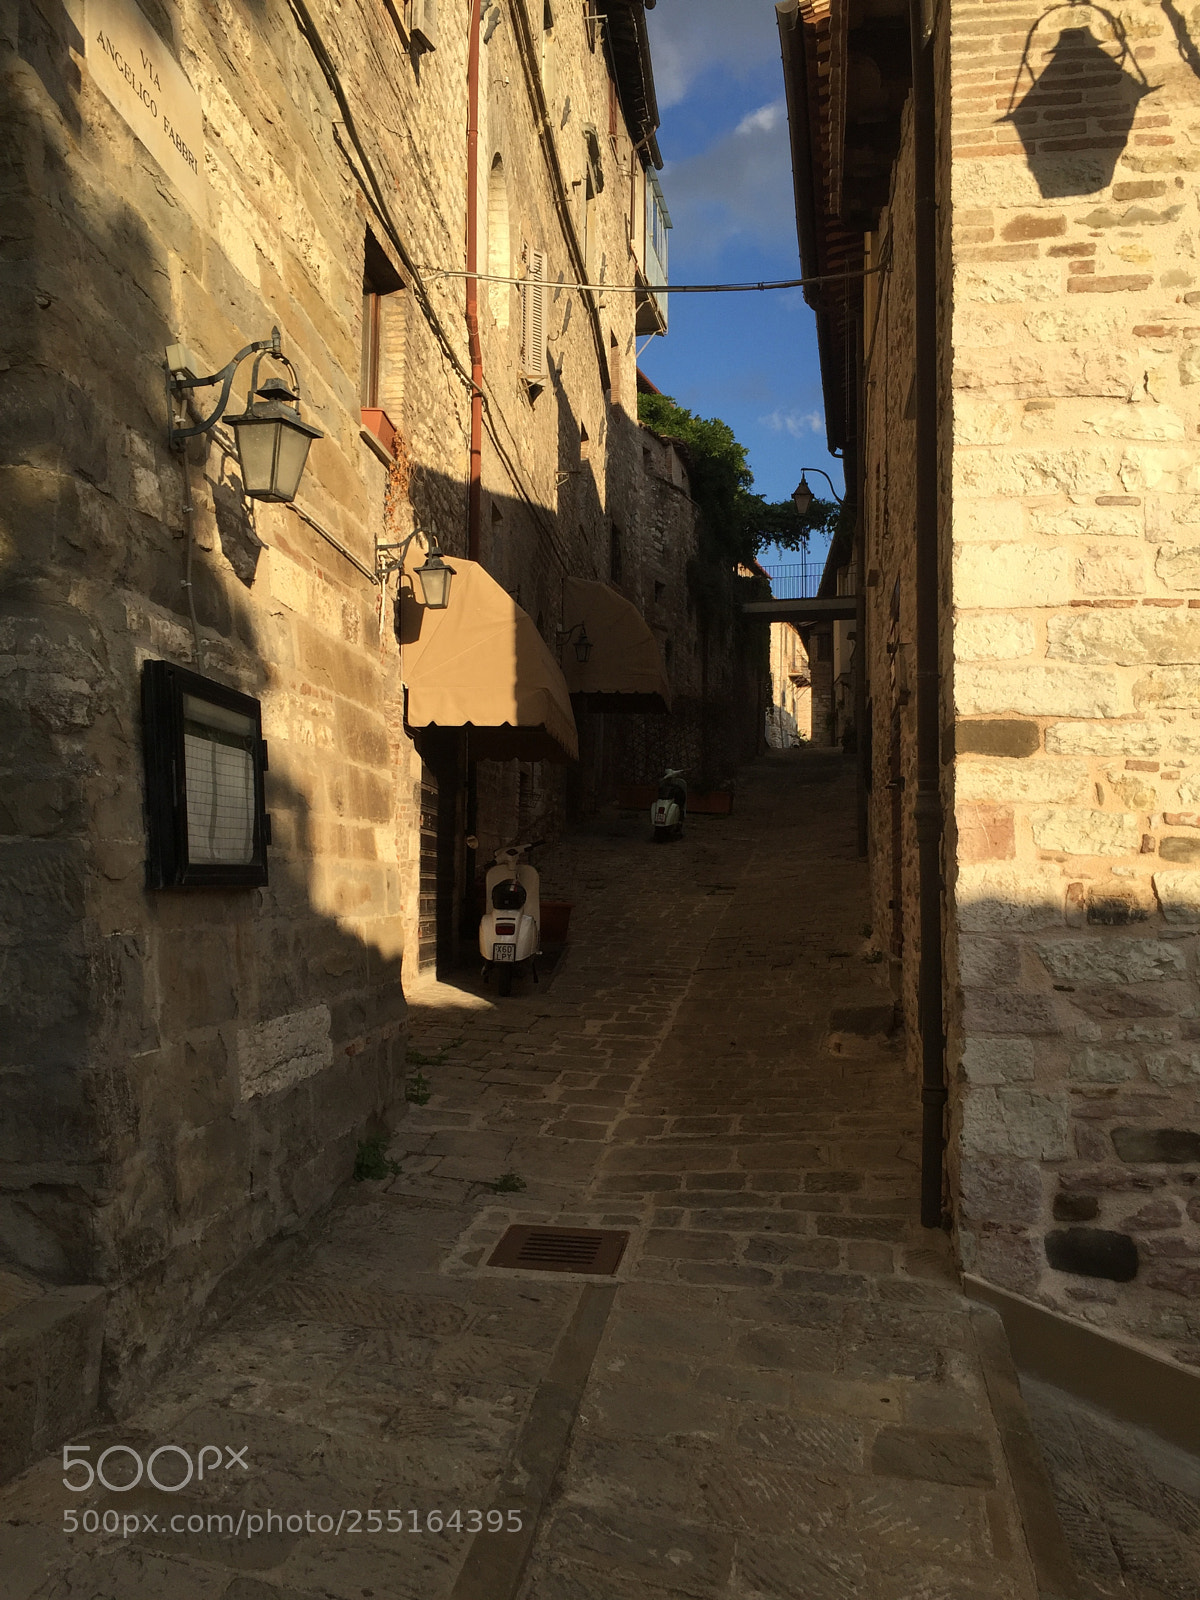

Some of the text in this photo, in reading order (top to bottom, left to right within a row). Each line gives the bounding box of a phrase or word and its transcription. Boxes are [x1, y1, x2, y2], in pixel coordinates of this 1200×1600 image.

[96, 30, 199, 176] ANGELICO FABBRI
[139, 48, 162, 93] VIA
